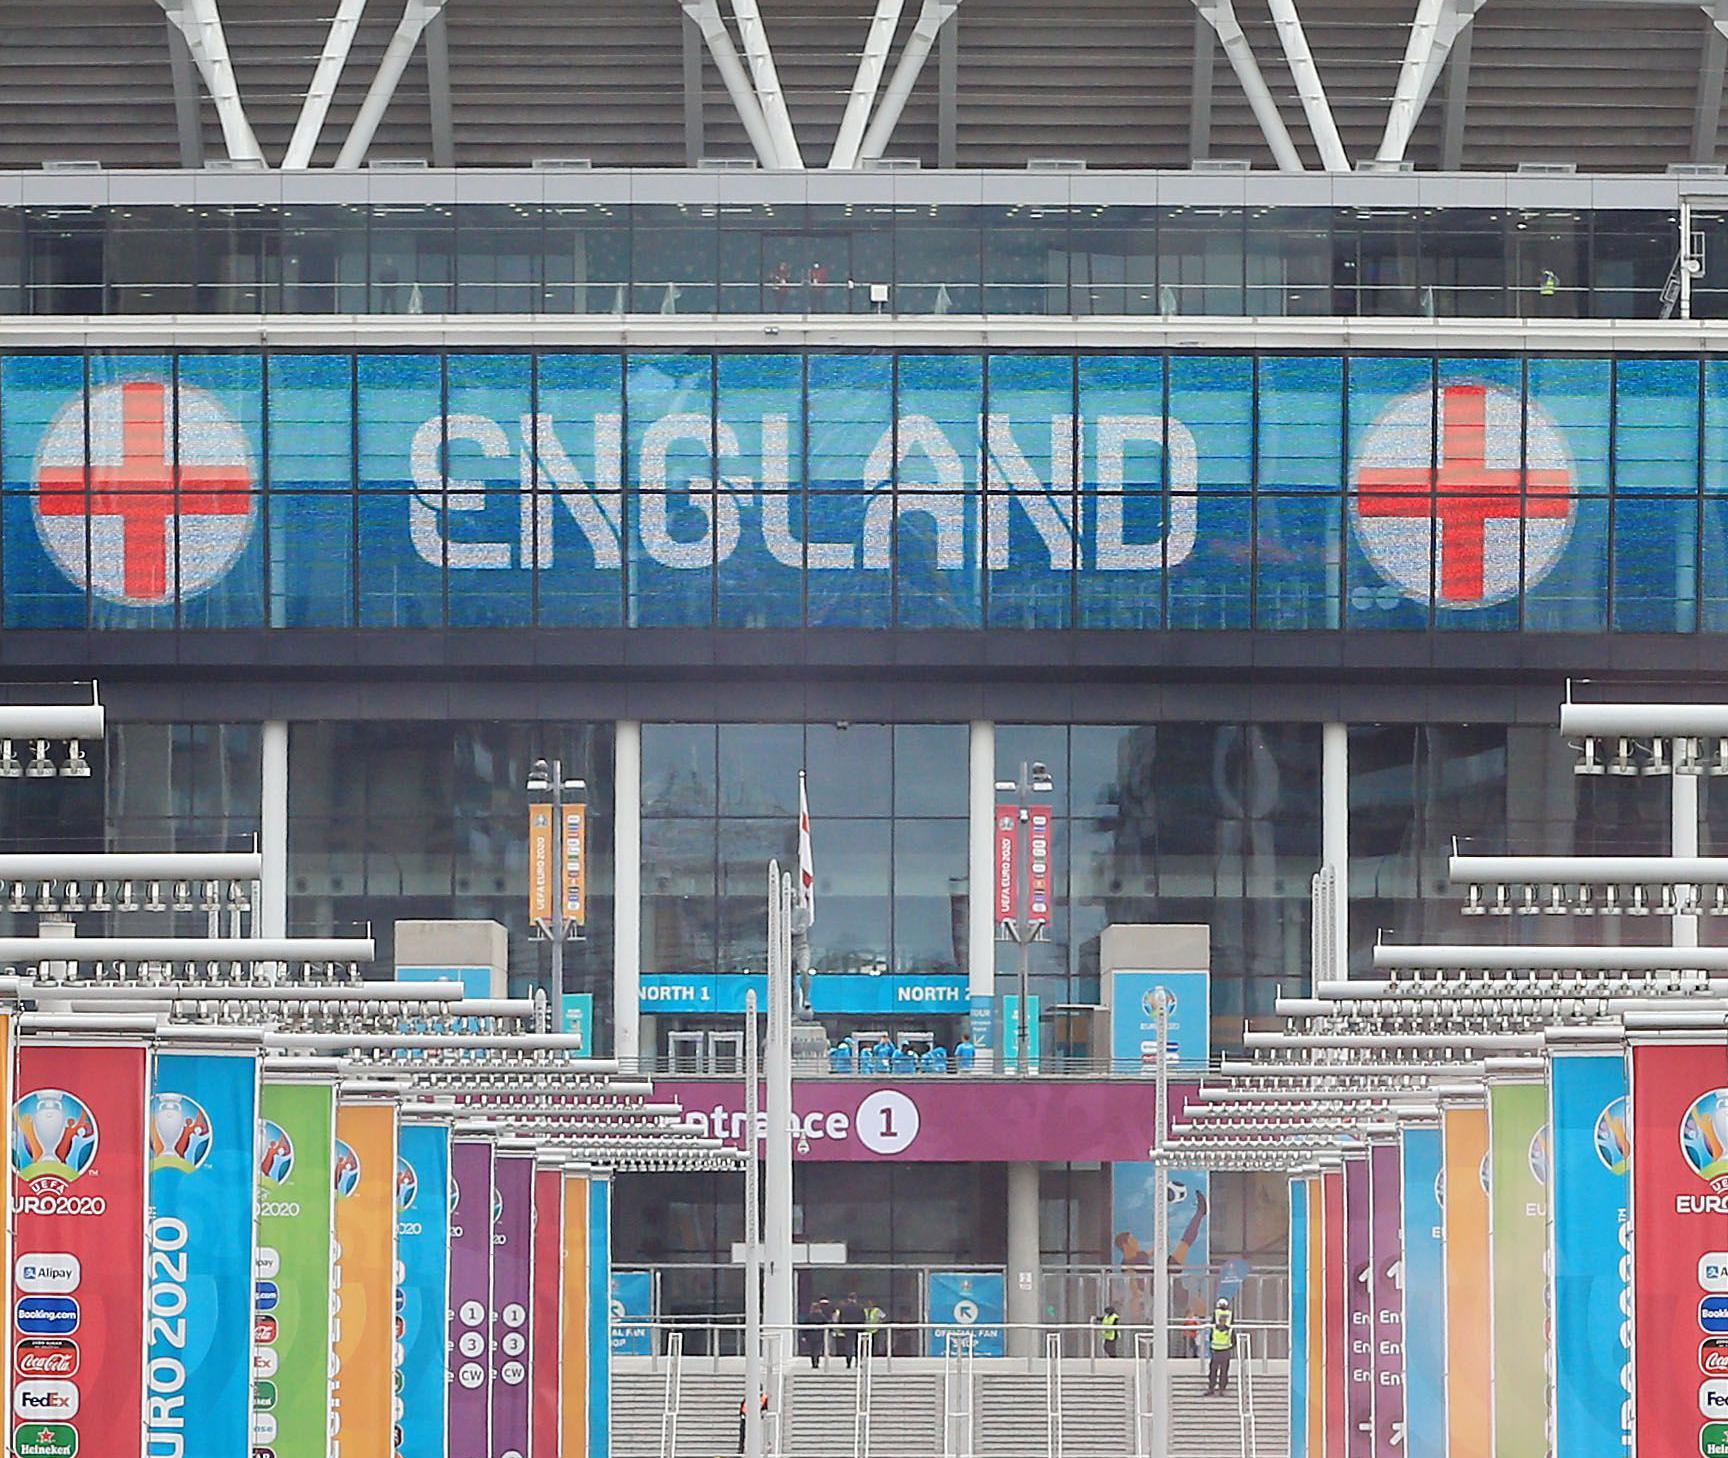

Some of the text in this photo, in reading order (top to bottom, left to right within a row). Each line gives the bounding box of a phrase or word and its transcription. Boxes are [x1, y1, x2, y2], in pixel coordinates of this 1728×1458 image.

[410, 413, 1196, 571] ENGLAND
[700, 986, 710, 1000] 1
[898, 987, 959, 1001] NORTH
[878, 1107, 898, 1137] 1
[31, 1179, 67, 1194] UEFA
[12, 1196, 107, 1215] URO2020
[256, 1202, 300, 1217] 2020
[38, 1267, 73, 1281] Alipay
[147, 1217, 188, 1350] 2020
[18, 1309, 77, 1322] Booking.com
[468, 1307, 477, 1320] 1
[511, 1310, 518, 1321] 1
[467, 1338, 476, 1351] 3
[510, 1338, 518, 1350] 3
[461, 1370, 482, 1381] CW
[503, 1368, 522, 1378] CW
[22, 1392, 69, 1408] FedEx
